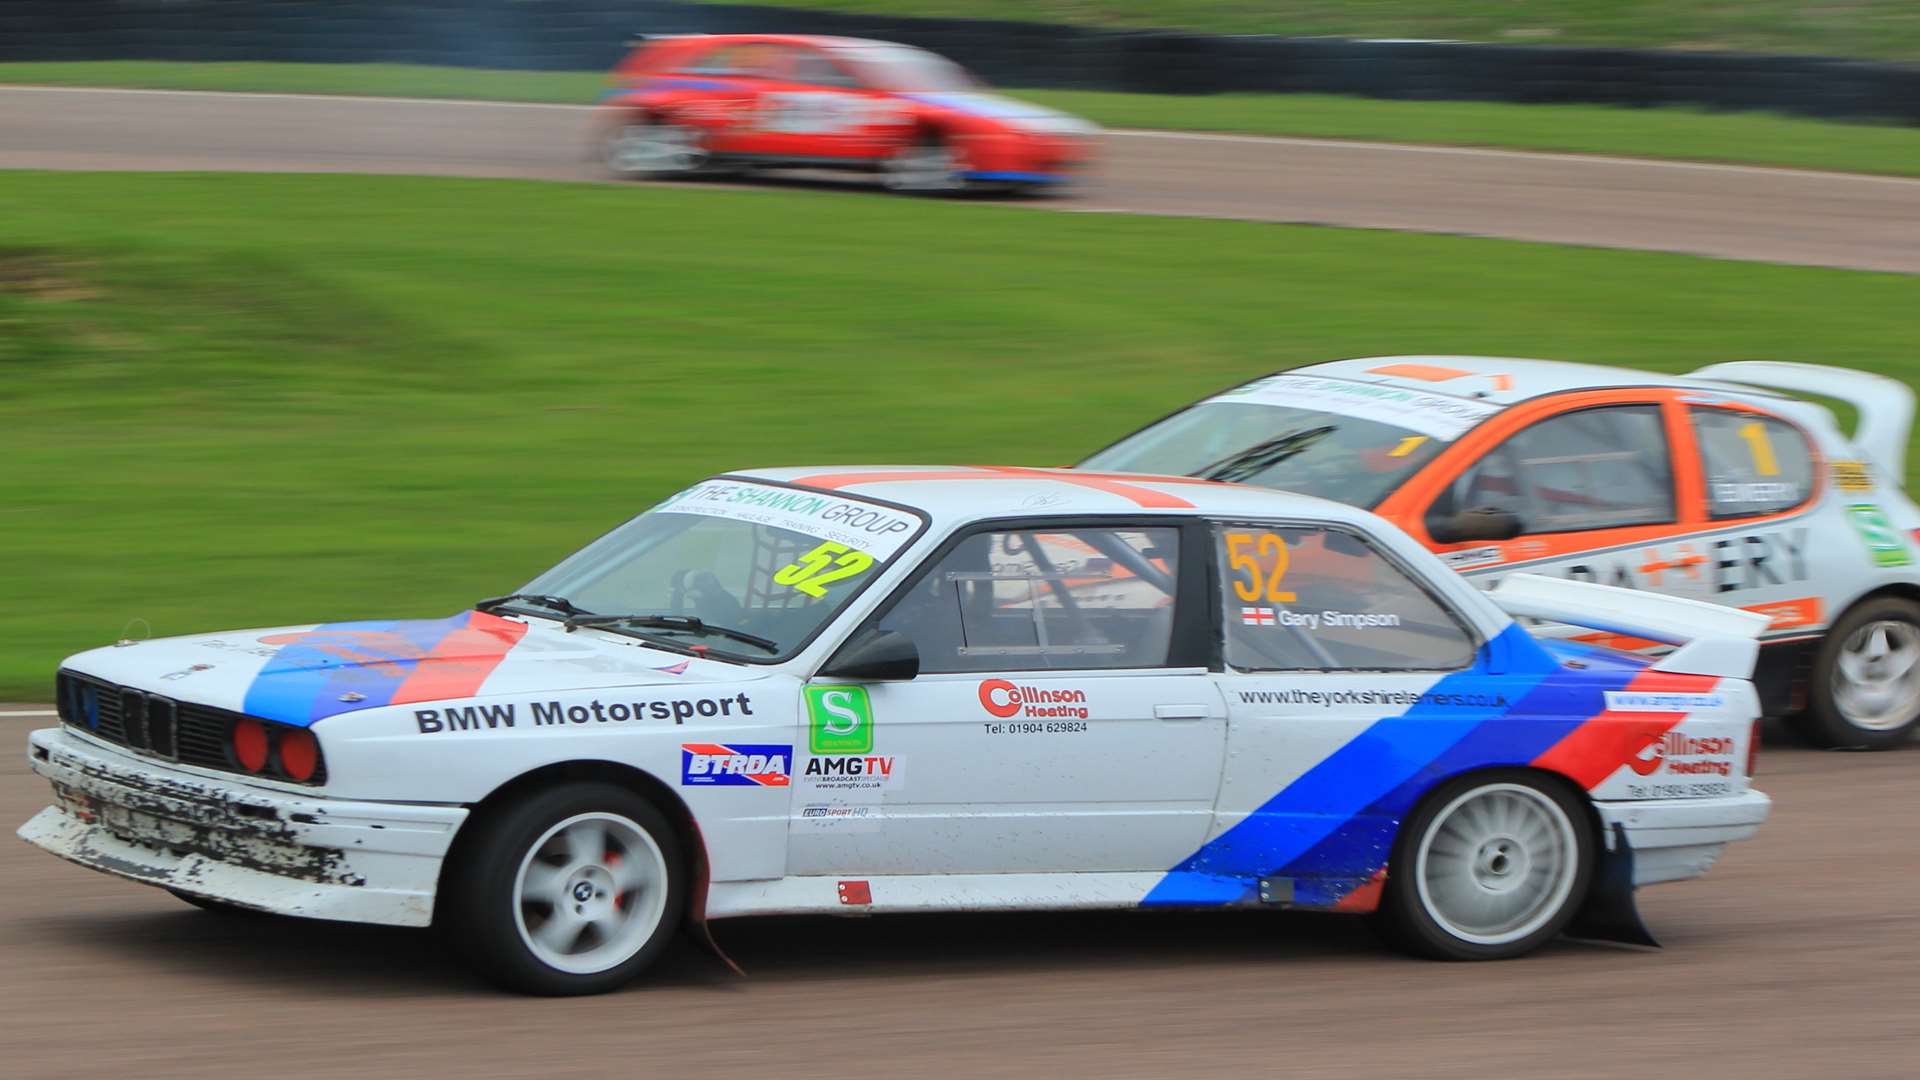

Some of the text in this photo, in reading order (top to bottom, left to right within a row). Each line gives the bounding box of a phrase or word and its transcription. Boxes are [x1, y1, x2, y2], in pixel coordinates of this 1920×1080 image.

[1738, 422, 1780, 476] 1
[692, 486, 909, 535] THE SHANNON GROUP
[773, 540, 875, 598] 52
[1225, 531, 1297, 602] 52
[1278, 610, 1401, 630] Gary Simpson
[414, 691, 754, 734] BMW Motorsport
[822, 691, 861, 735] S
[978, 678, 1086, 718] Collinson
[1025, 706, 1088, 719] Heating
[984, 722, 1088, 734] Tel: 01904 629824
[687, 754, 786, 775] BTRDA
[805, 757, 894, 776] AMGTV
[815, 782, 881, 790] www.amgtv.co.uk
